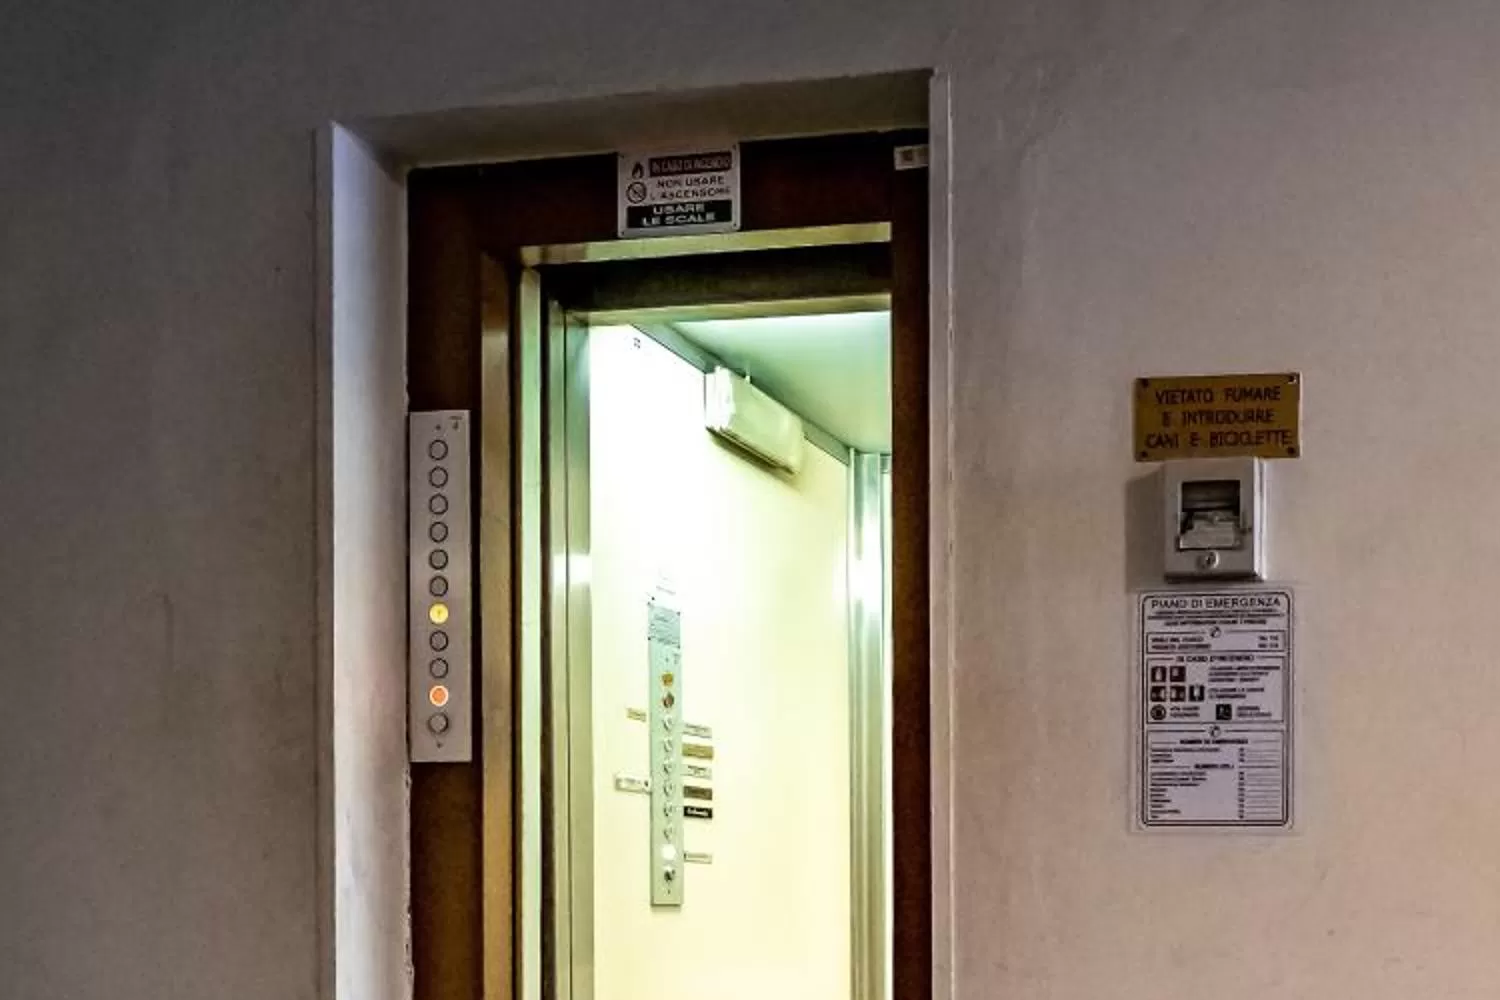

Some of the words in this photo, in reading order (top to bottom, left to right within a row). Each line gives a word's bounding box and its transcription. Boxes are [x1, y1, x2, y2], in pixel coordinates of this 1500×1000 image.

[657, 179, 682, 189] NON
[685, 175, 725, 187] USARE
[652, 203, 706, 216] USARE
[641, 215, 661, 228] LE
[664, 211, 717, 226] SCALE
[1155, 387, 1213, 405] VIETATO
[1223, 385, 1281, 402] FUMARE
[1145, 432, 1180, 449] CANI
[1209, 429, 1292, 448] BICICLETTE
[1151, 599, 1187, 609] PIANO
[1191, 599, 1203, 609] DI
[1205, 597, 1281, 609] EMERGENZA
